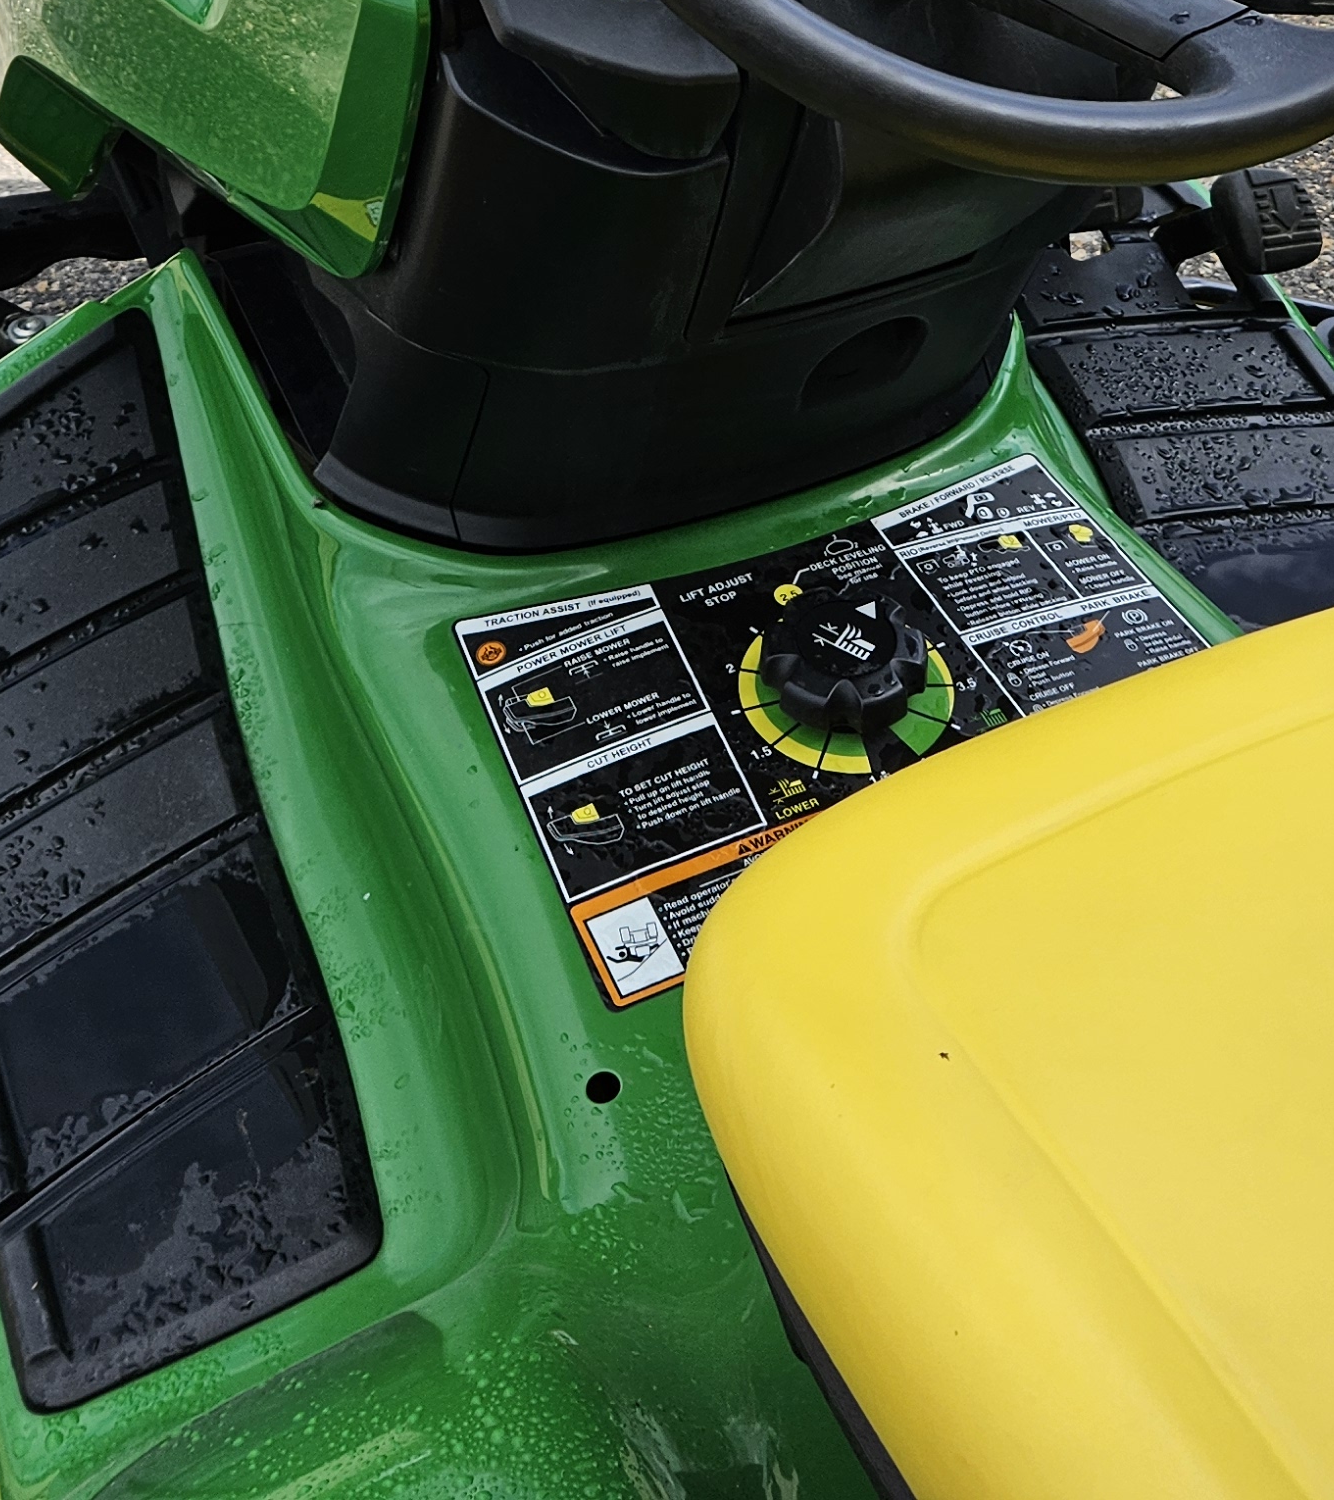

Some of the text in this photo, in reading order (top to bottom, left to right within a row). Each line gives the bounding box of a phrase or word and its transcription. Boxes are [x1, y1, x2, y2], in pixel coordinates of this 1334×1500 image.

[899, 464, 1015, 518] BRAKE FORWARD REVERSE
[1015, 504, 1037, 513] REV
[1022, 512, 1082, 527] MOWER/PTO
[942, 519, 966, 530] FWD
[809, 544, 886, 571] DECK LEVELING
[832, 556, 878, 575] POSITION
[900, 549, 918, 559] RIO
[1065, 557, 1097, 567] MOWER
[947, 570, 969, 580] keep
[967, 566, 987, 575] PTO
[985, 556, 1020, 570] engaged
[1079, 573, 1109, 584] MOWER
[679, 573, 753, 603] LIFT ADJUST
[704, 591, 737, 606] STOP
[1079, 588, 1150, 611] PARK BRAKE
[484, 610, 540, 627] TRACTION
[540, 601, 582, 615] ASSIST
[596, 589, 641, 604] equipped)
[522, 611, 614, 651] Push for added traction
[967, 610, 1063, 643] CRUISE CONTROL
[1113, 618, 1175, 638] PARK BRAKE ON
[516, 624, 626, 673] POWER MOWER LIFT
[563, 637, 631, 668] RAISE MOWER
[607, 636, 664, 660] Raise handle to
[1034, 650, 1050, 660] ON
[725, 663, 736, 674] 2
[956, 678, 977, 691] 3.5
[1028, 687, 1059, 701] CRUISE
[1057, 682, 1077, 692] OFF
[585, 691, 659, 725] LOWER MOWER
[631, 691, 691, 718] Lower handle to
[635, 698, 697, 725] lower implement
[586, 737, 653, 768] CUT HEIGHT
[751, 746, 772, 760] 1.5
[618, 758, 709, 798] TO SET CUT HEIGHT
[628, 793, 646, 804] Pull
[646, 788, 658, 798] up
[658, 784, 670, 793] on
[670, 779, 682, 789] lift
[633, 779, 710, 812] Turn lift adjust stop
[636, 790, 704, 820] to desired height
[641, 786, 741, 829] Push down on lift handle
[775, 798, 819, 820] LOWER
[664, 896, 689, 911] Read
[670, 894, 723, 919] Avoid sudd
[673, 920, 680, 929] If
